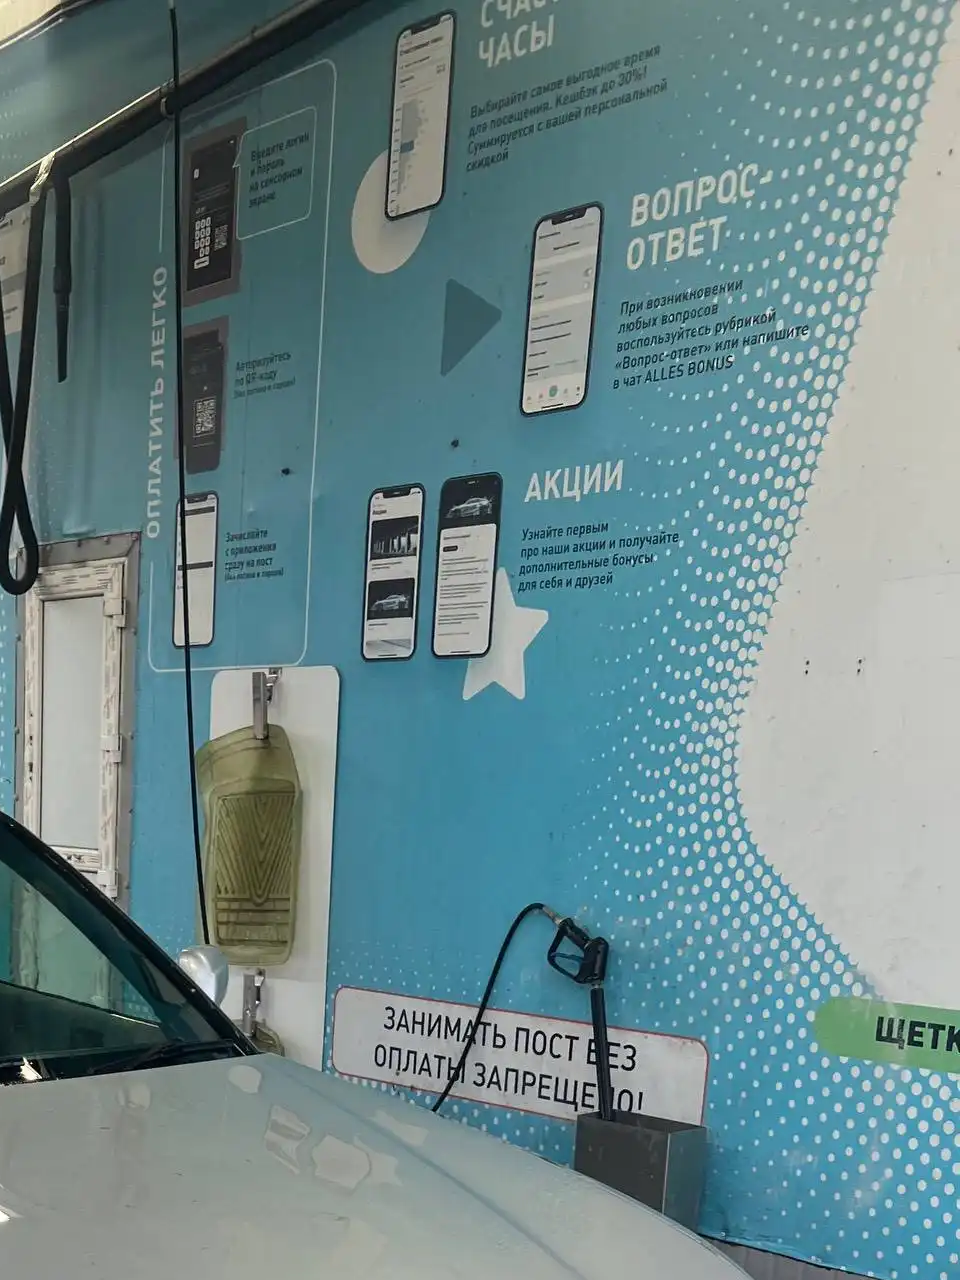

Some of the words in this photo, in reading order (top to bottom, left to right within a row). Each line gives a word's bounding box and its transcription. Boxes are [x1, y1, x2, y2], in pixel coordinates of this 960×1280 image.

[479, 14, 555, 68] ЧАСЫ
[468, 122, 488, 139] для
[490, 103, 552, 130] посещения.
[555, 87, 598, 109] Кешбэк
[600, 79, 616, 96] до
[618, 65, 648, 88] 30%!
[470, 90, 527, 119] Выбирайте
[531, 79, 563, 99] самое
[566, 62, 620, 86] выгодное
[624, 45, 661, 68] время
[468, 123, 535, 155] Суммируется
[537, 121, 544, 132] с
[545, 106, 581, 130] вашей
[584, 78, 668, 116] персональной
[466, 149, 509, 172] скидкой
[631, 163, 773, 228] ВОПРОС-
[626, 216, 728, 271] ОТВЕТ
[150, 266, 168, 369] ЛЕГКО
[618, 317, 657, 334] любых
[661, 303, 719, 326] вопросов
[620, 301, 644, 317] При
[646, 279, 744, 310] возникновении
[615, 343, 711, 370] «Вопрос-ответ»
[715, 338, 739, 352] или
[742, 324, 810, 347] напишите
[616, 323, 711, 353] воспользуйтесь
[714, 308, 777, 337] рубрикой
[612, 379, 620, 390] в
[623, 374, 643, 388] чат
[644, 361, 684, 384] ALLES
[687, 354, 735, 376] BONUS
[146, 377, 164, 539] ОПЛАТИТЬ
[524, 459, 625, 503] АКЦИИ
[520, 546, 539, 560] про
[542, 544, 570, 556] наши
[573, 540, 606, 554] акции
[609, 539, 616, 549] и
[619, 532, 679, 551] получайте
[522, 526, 563, 541] Узнайте
[566, 522, 609, 537] первым
[518, 580, 537, 593] для
[540, 576, 563, 589] себя
[566, 577, 572, 588] и
[575, 571, 613, 589] друзей
[519, 556, 609, 576] дополнительные
[612, 553, 654, 567] бонусы
[384, 1006, 506, 1049] ЗАНИМАТЬ
[514, 1026, 579, 1061] ПОСТ
